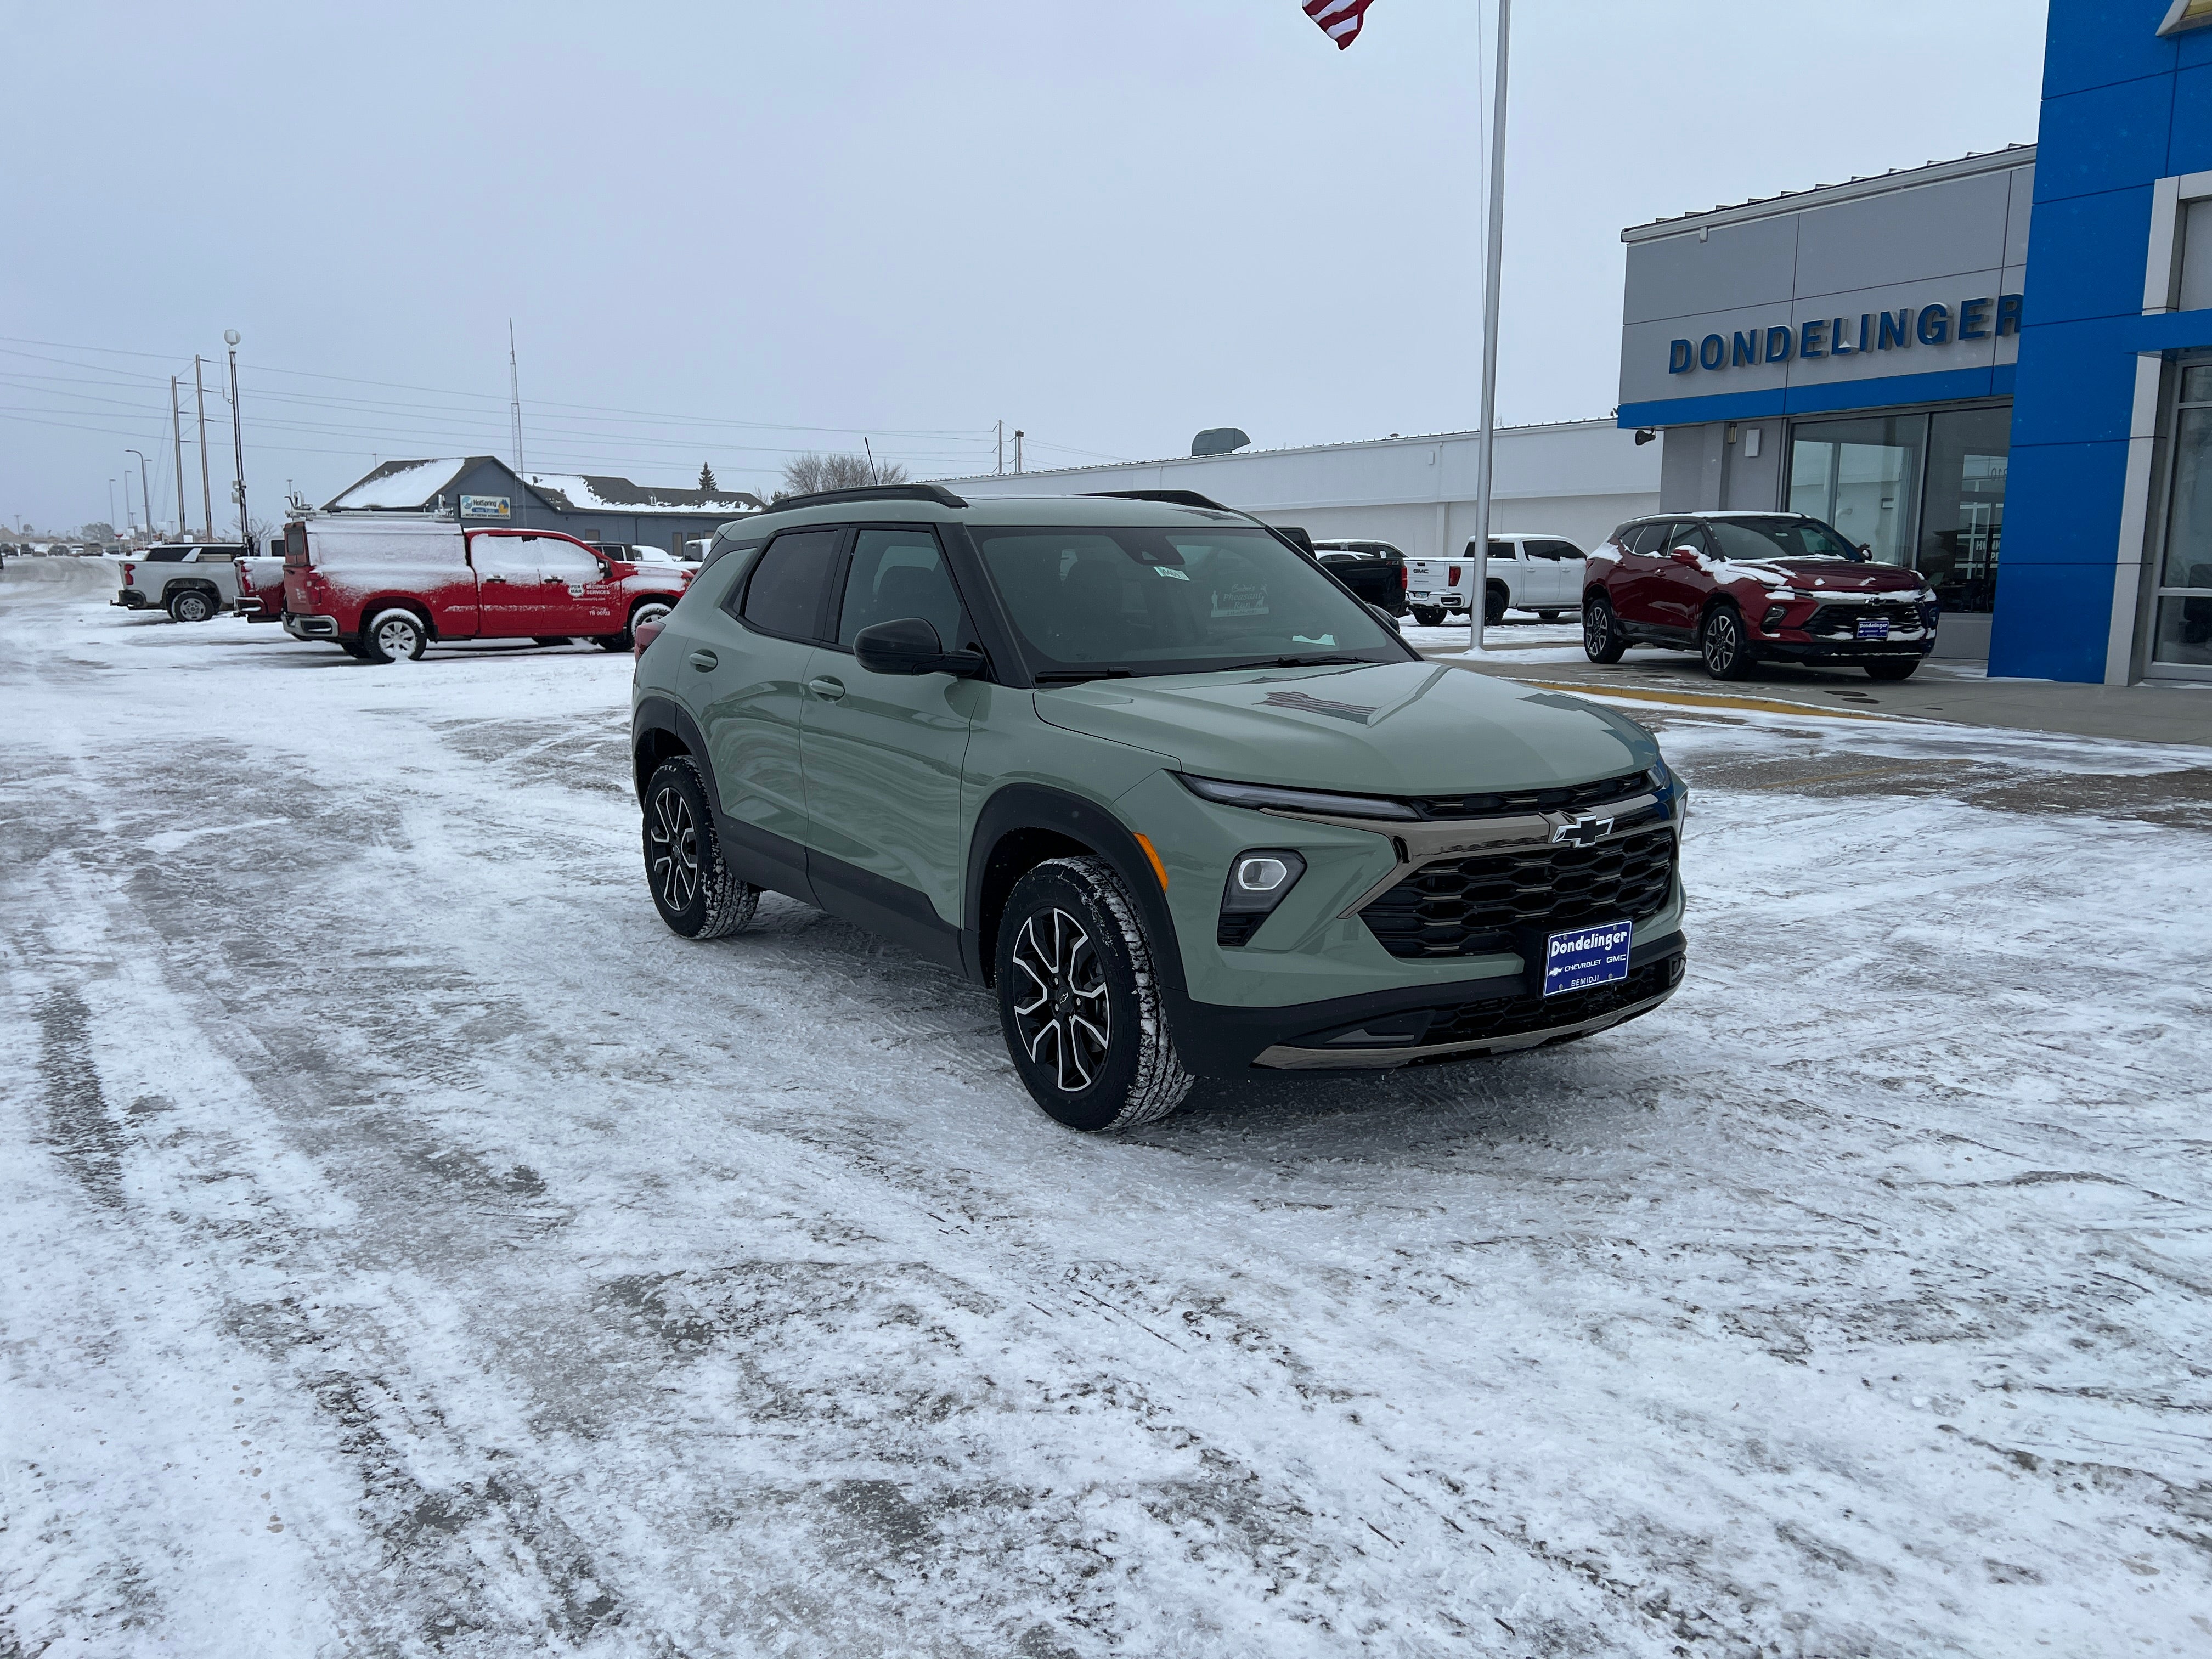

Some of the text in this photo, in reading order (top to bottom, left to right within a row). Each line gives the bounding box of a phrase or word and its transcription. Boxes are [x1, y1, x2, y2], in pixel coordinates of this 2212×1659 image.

[1669, 294, 2023, 375] DONDELINGER
[473, 499, 497, 507] HotSpring
[1223, 592, 1262, 601] Pheasant
[1233, 601, 1251, 610] Run
[1551, 932, 1628, 957] Dondelinger
[1564, 953, 1627, 972] CHEVROLET GMC
[1571, 974, 1600, 988] BEMIDJI
